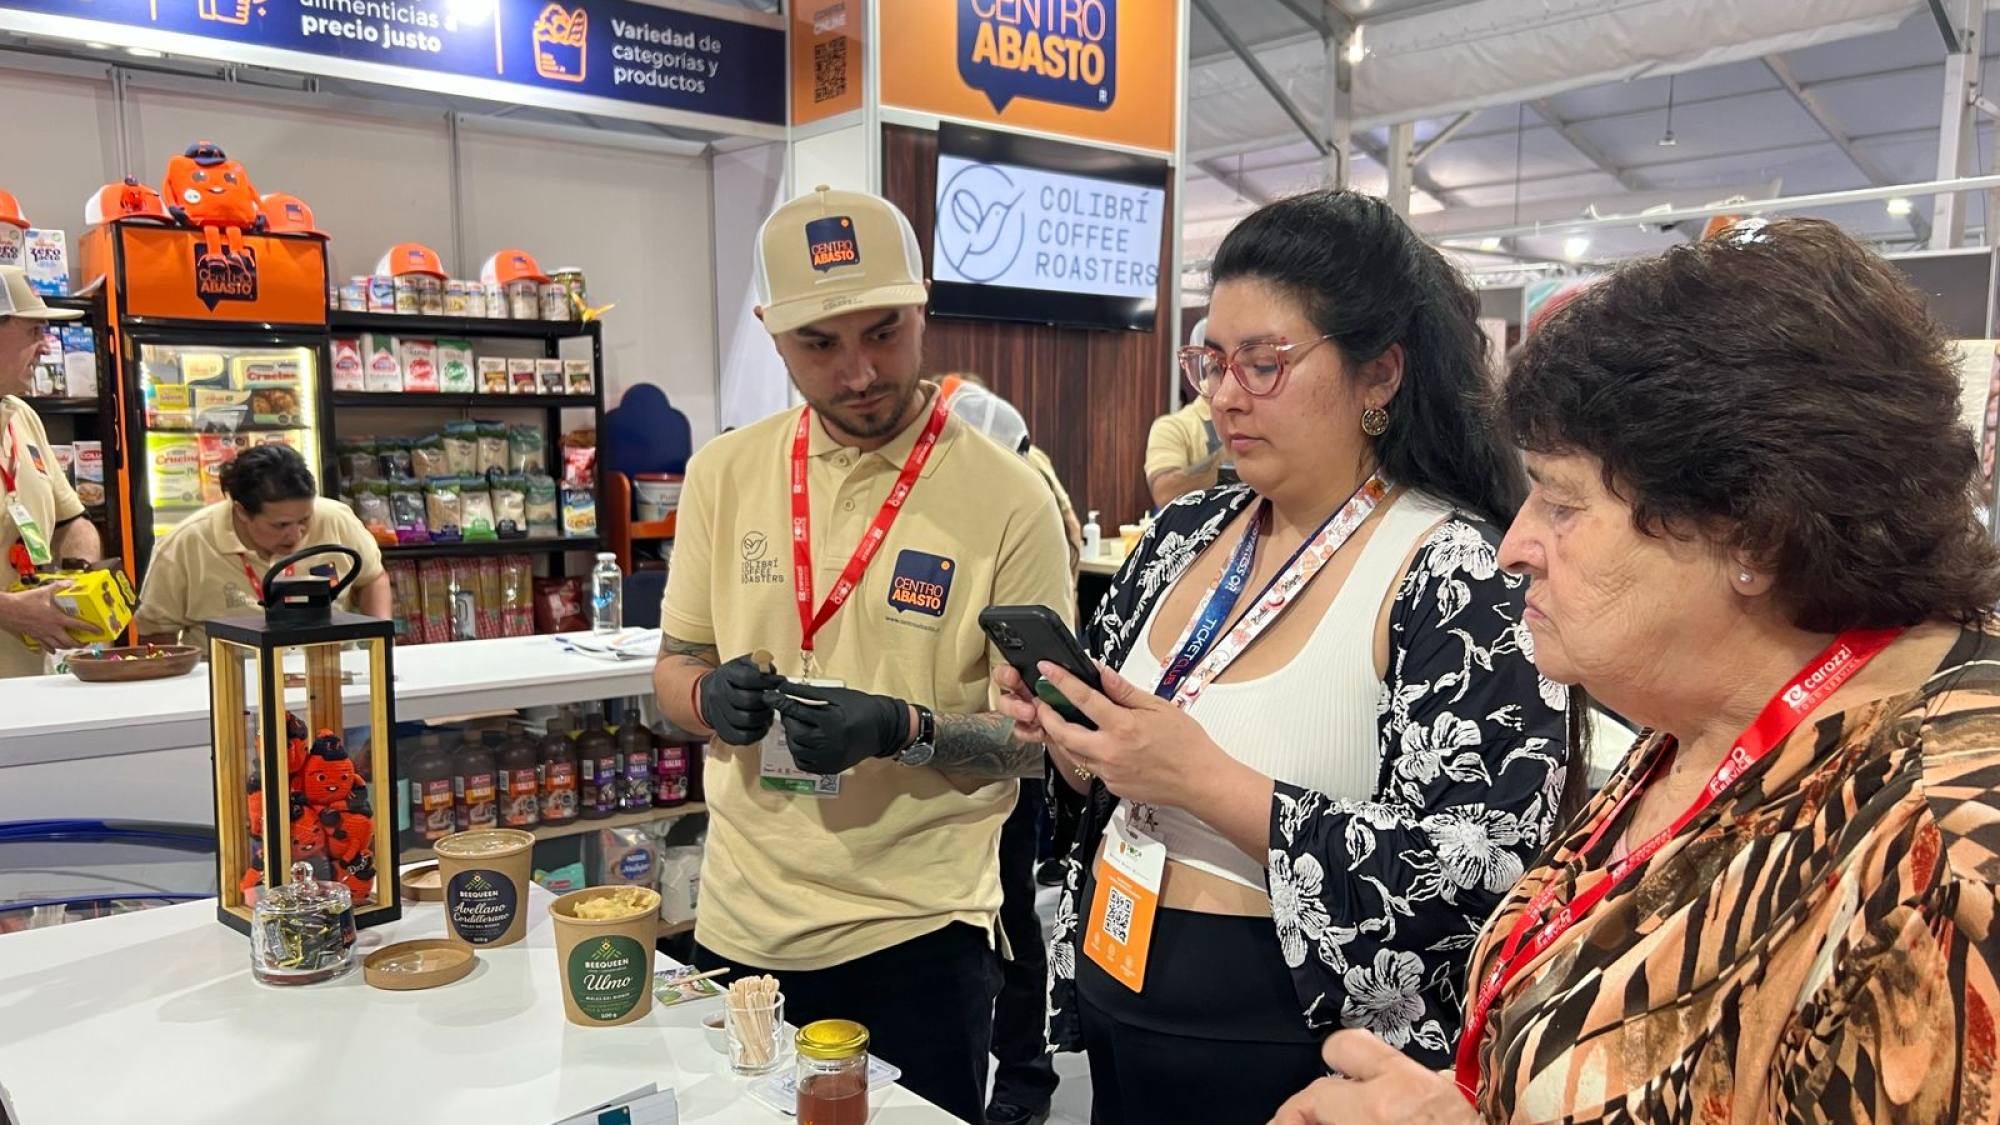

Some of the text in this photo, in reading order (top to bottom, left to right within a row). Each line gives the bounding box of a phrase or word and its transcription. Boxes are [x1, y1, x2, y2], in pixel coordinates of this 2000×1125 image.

[302, 14, 442, 52] precio justo
[971, 0, 1106, 41] CENTRO
[611, 18, 722, 53] Variedad de
[611, 44, 719, 78] categorías y
[972, 21, 1106, 86] ABASTO
[613, 65, 706, 94] productos
[1040, 184, 1150, 224] COLIBRÍ
[810, 240, 854, 256] CENTRO
[1038, 219, 1131, 254] COFFEE
[814, 249, 856, 266] ABASTO
[1034, 250, 1159, 287] ROASTERS
[201, 280, 252, 295] ABASTO
[892, 589, 941, 610] ABASTO
[894, 576, 944, 598] CENTRO
[1804, 643, 1853, 689] carozzi
[459, 890, 499, 898] BEEQUEEN
[453, 901, 506, 915] Avellano
[453, 912, 510, 923] Cordillerano
[584, 957, 630, 969] BEEQUEEN
[583, 974, 634, 991] Ulmo
